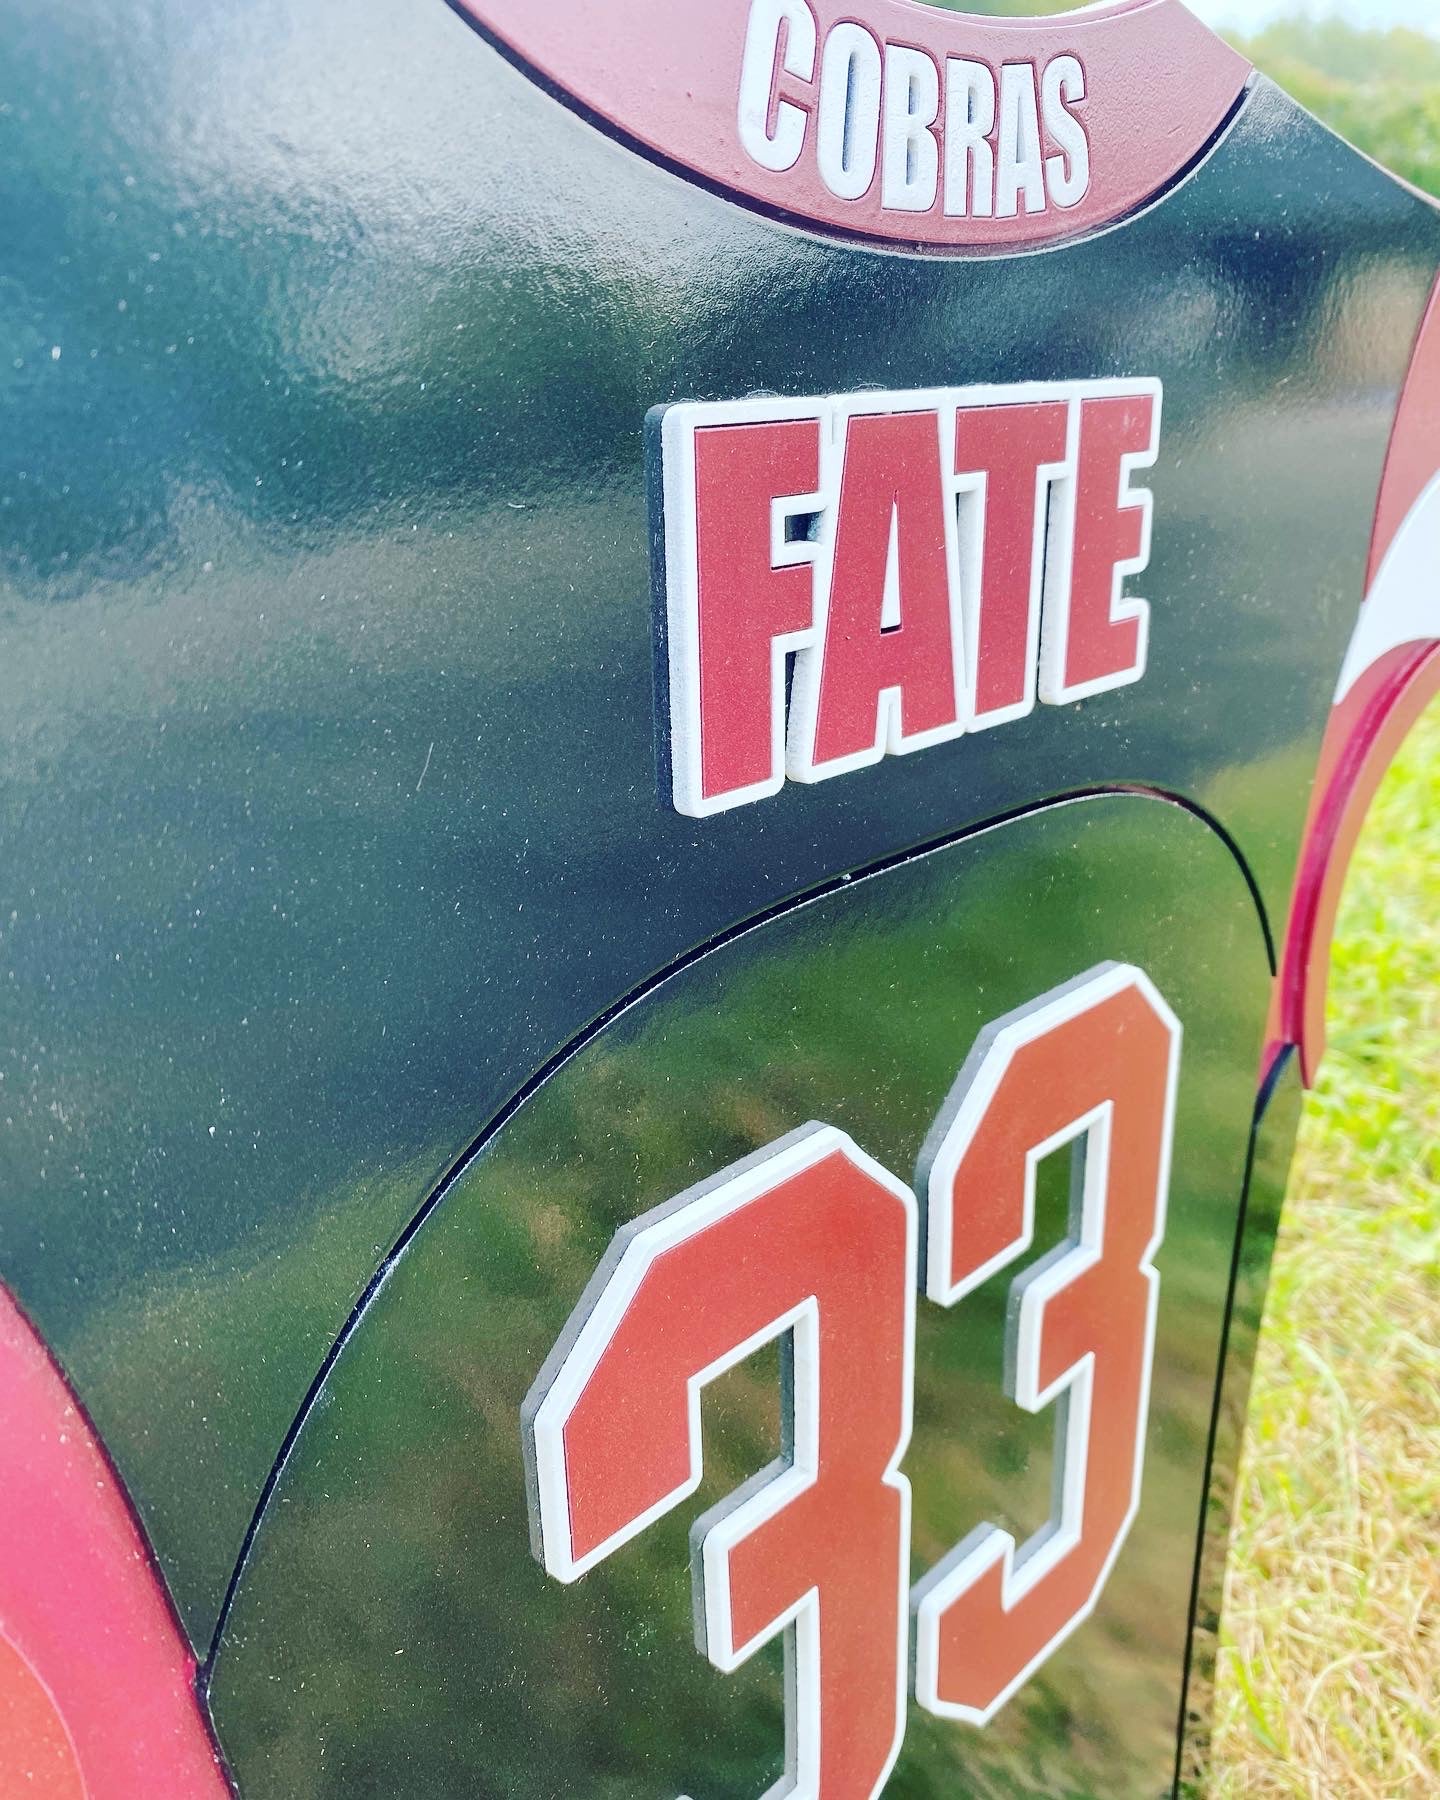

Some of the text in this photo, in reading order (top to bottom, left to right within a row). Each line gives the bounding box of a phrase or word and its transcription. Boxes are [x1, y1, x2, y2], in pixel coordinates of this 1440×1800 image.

[737, 0, 1090, 219] COBRAS
[660, 377, 1163, 818] FATE
[523, 962, 1183, 1800] 33
